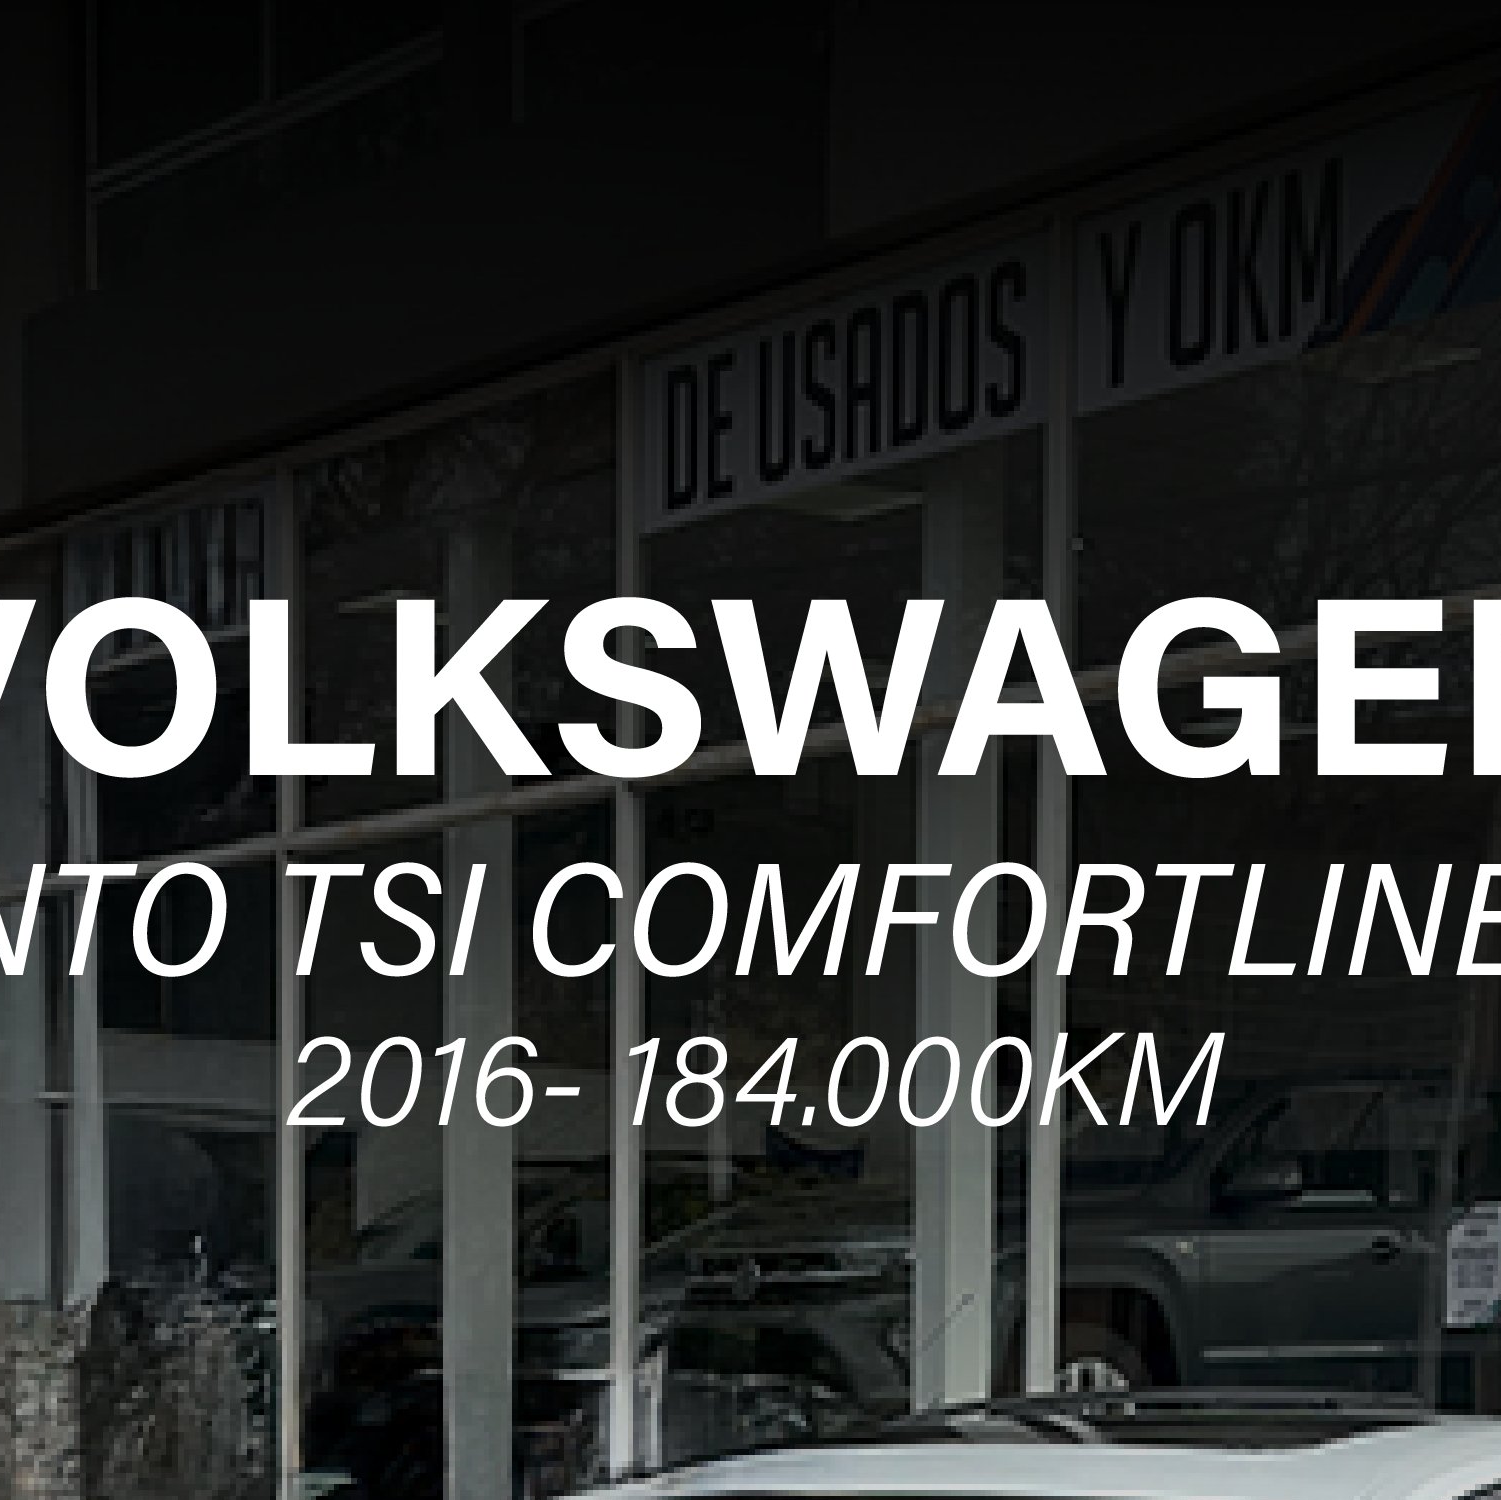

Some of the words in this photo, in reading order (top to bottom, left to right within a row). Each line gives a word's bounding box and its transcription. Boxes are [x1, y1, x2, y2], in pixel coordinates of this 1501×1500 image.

[666, 349, 735, 510] DE
[758, 259, 1027, 482] USADOS
[1095, 222, 1138, 388] Y
